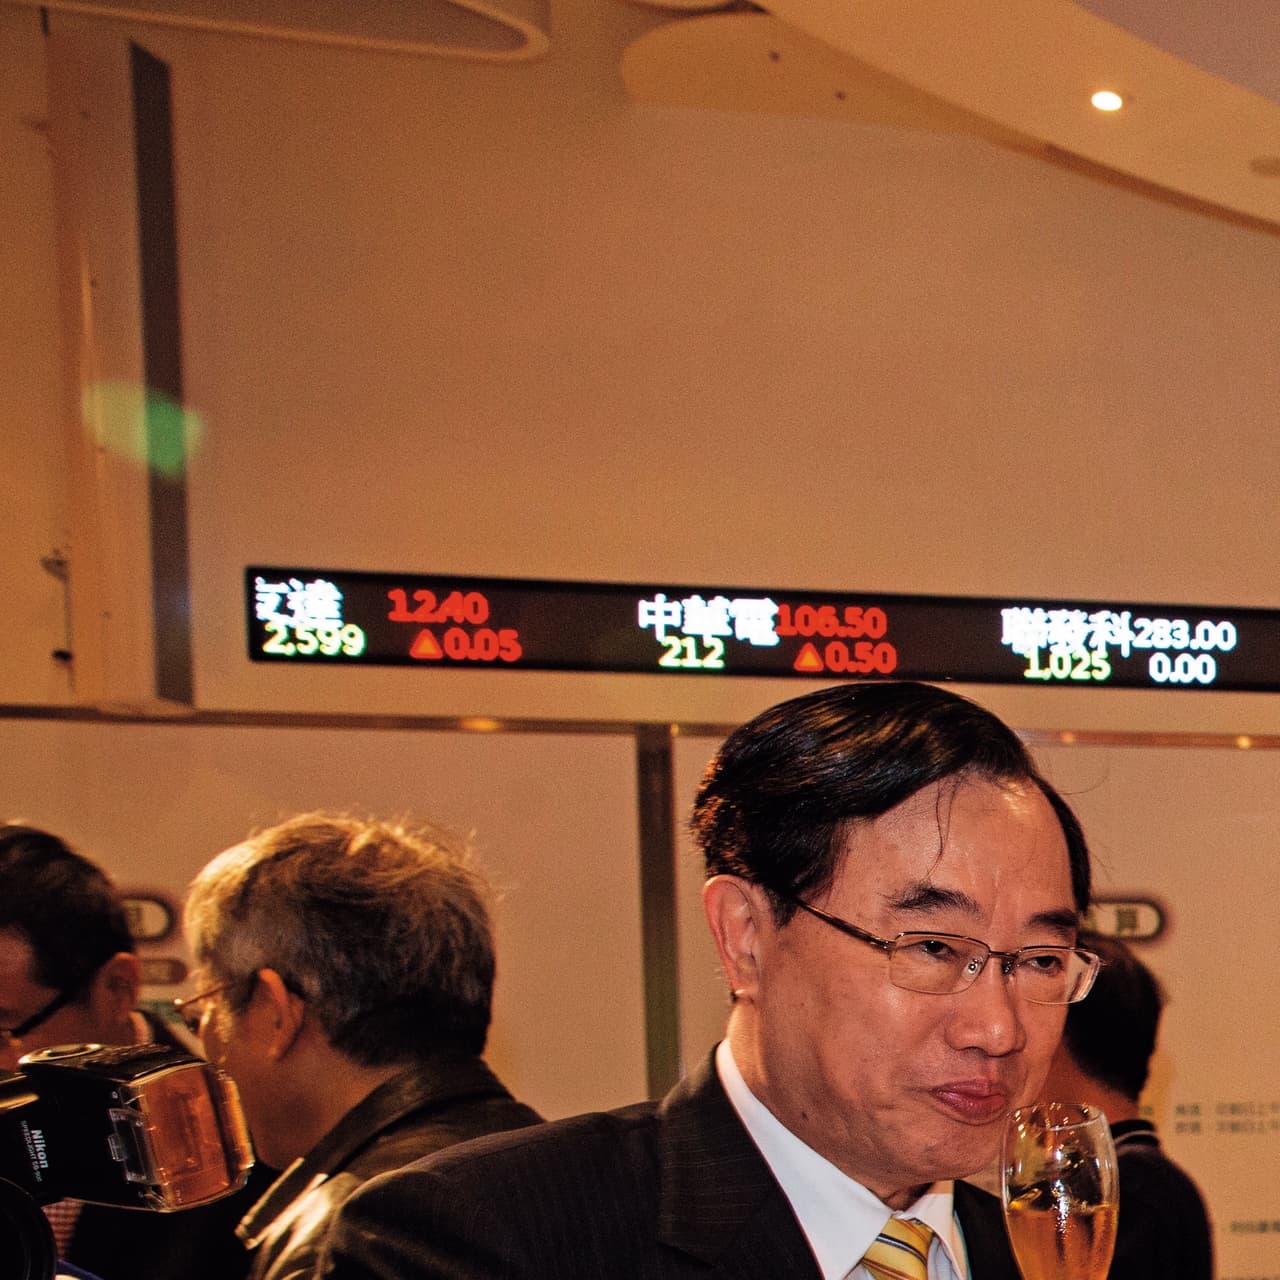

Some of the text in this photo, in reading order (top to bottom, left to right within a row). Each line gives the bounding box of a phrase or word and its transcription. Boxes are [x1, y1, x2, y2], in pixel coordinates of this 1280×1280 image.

[776, 604, 888, 639] 106.50
[1132, 617, 1237, 651] 283.00
[443, 627, 522, 663] 0.05
[658, 635, 897, 674] 212 0.50
[1148, 652, 1217, 684] 0.00
[31, 1130, 48, 1168] Nikon
